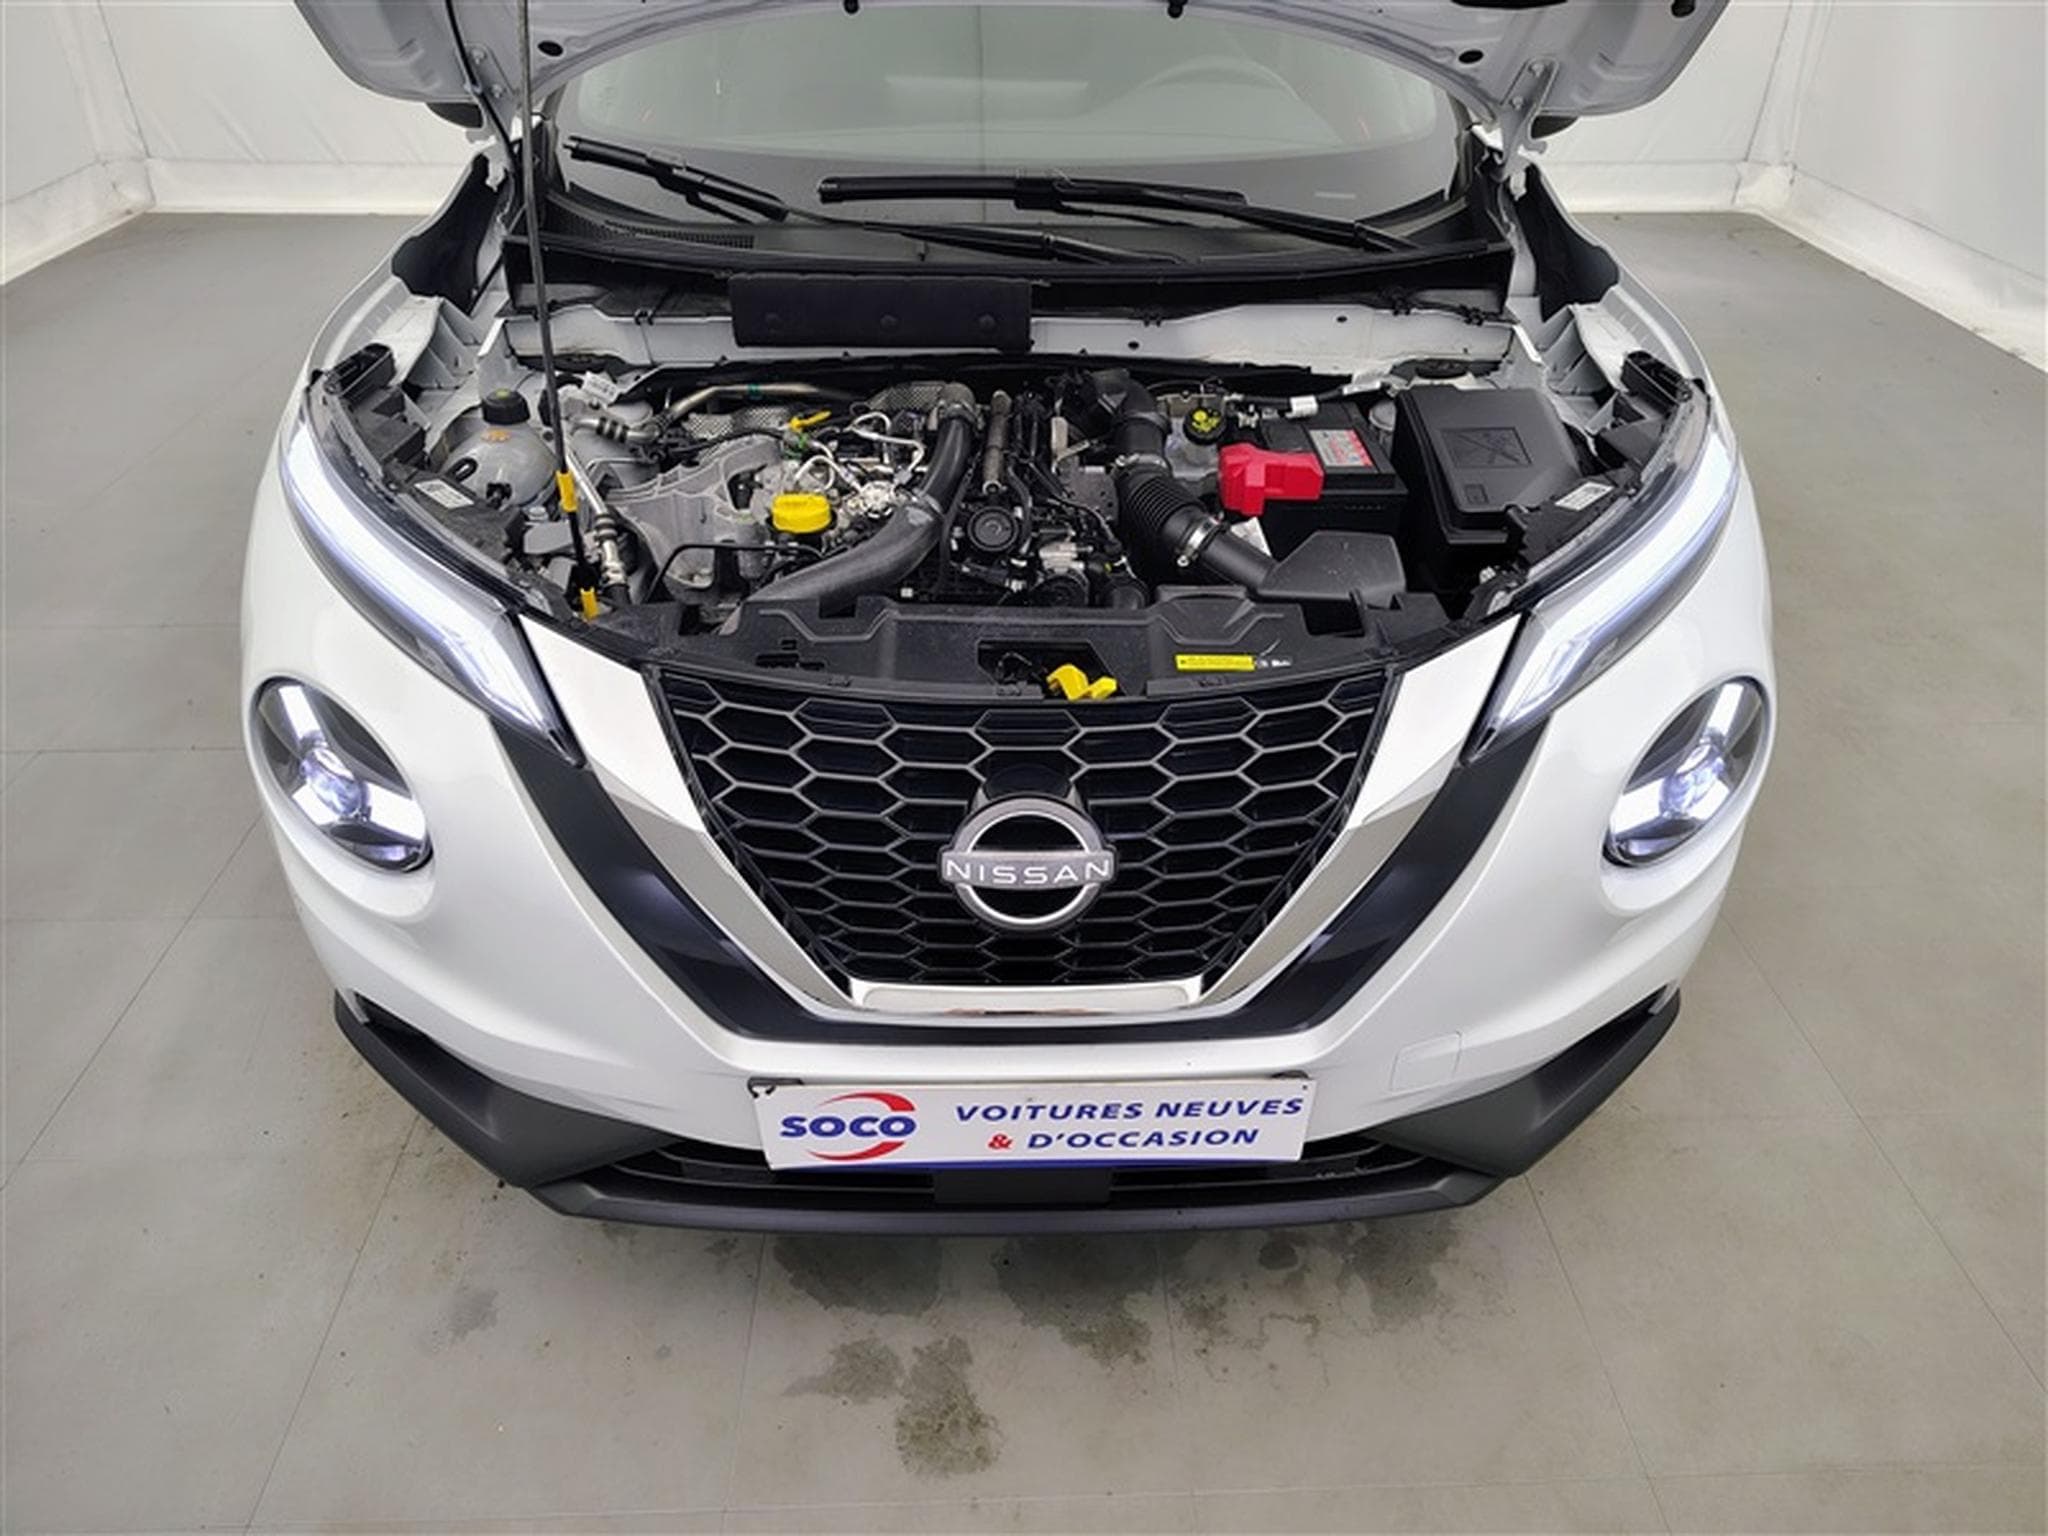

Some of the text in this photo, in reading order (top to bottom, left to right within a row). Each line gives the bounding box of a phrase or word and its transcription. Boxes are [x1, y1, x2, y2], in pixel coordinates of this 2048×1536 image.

[946, 860, 1109, 884] NISSAN
[955, 1098, 1304, 1122] VOITURES NEUVES
[780, 1116, 917, 1138] SOCO
[988, 1129, 1260, 1150] & D'OCCASION
